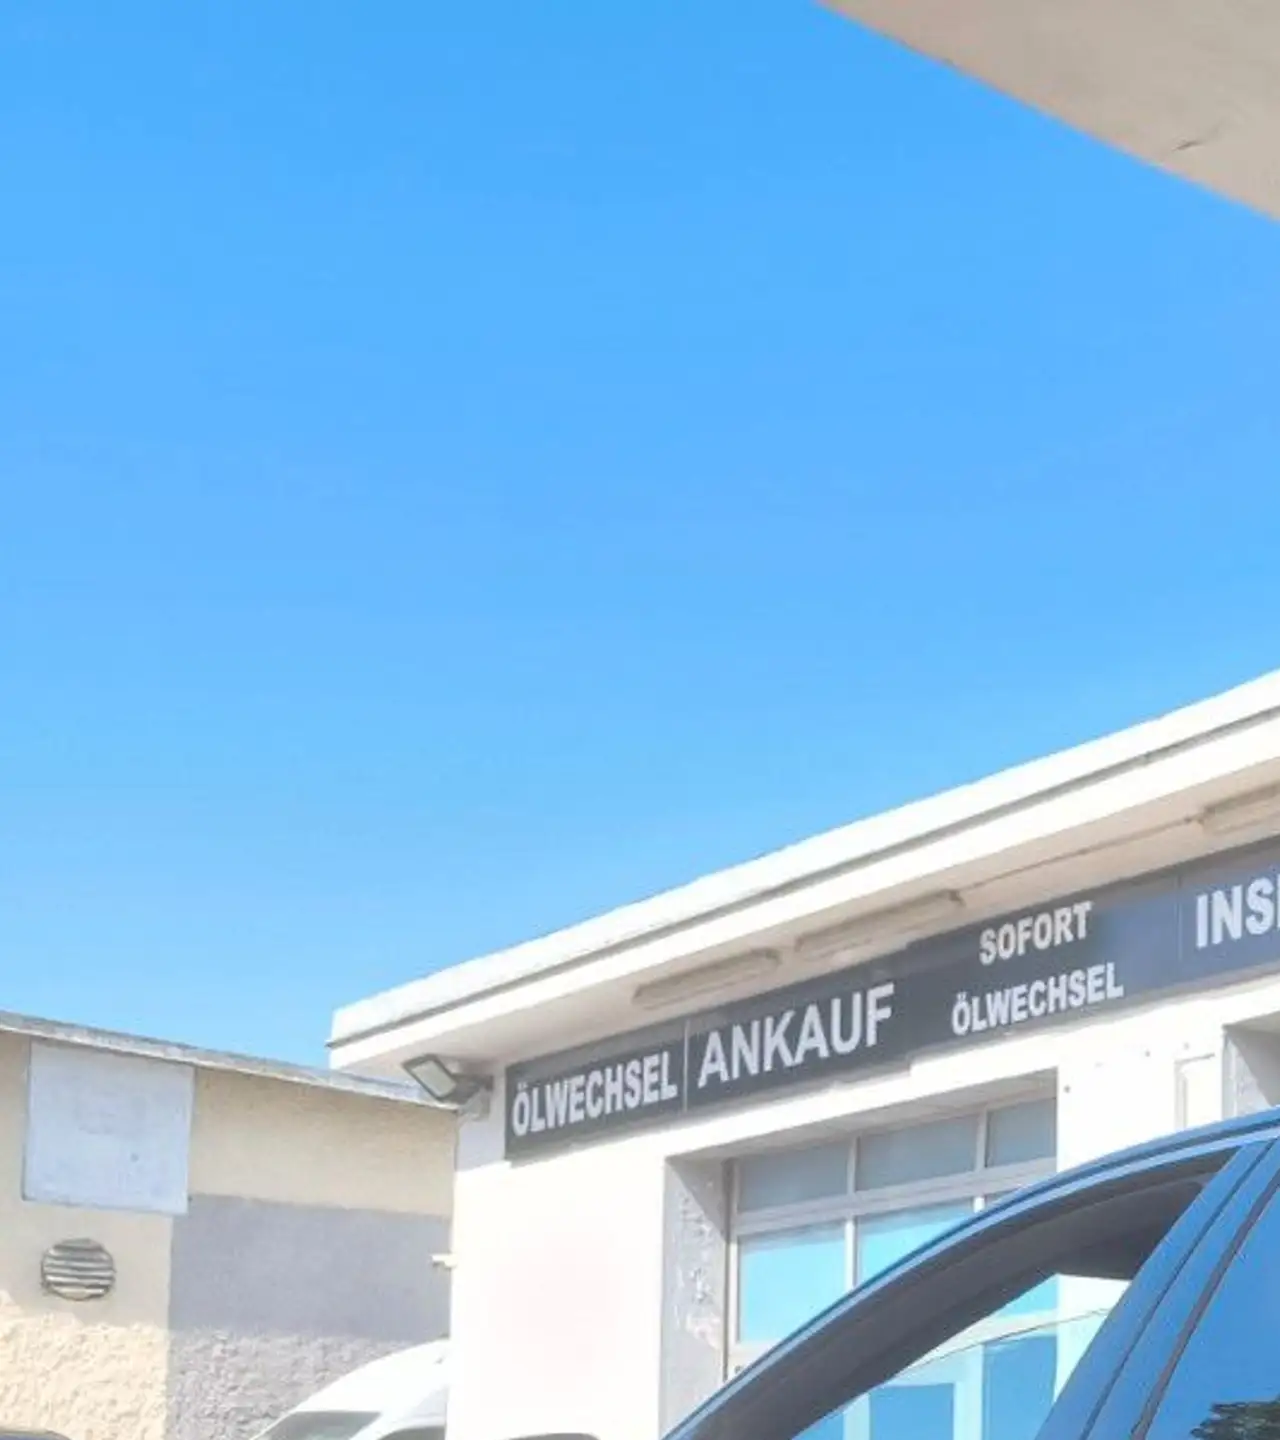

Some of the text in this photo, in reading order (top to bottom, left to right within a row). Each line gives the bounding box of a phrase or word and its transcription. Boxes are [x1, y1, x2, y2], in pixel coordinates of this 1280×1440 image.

[979, 901, 1093, 967] SOFORT
[697, 982, 895, 1090] ANKAUF
[951, 961, 1125, 1037] ÖLWECHSEL
[511, 1049, 678, 1137] ÖLWECHSEL
